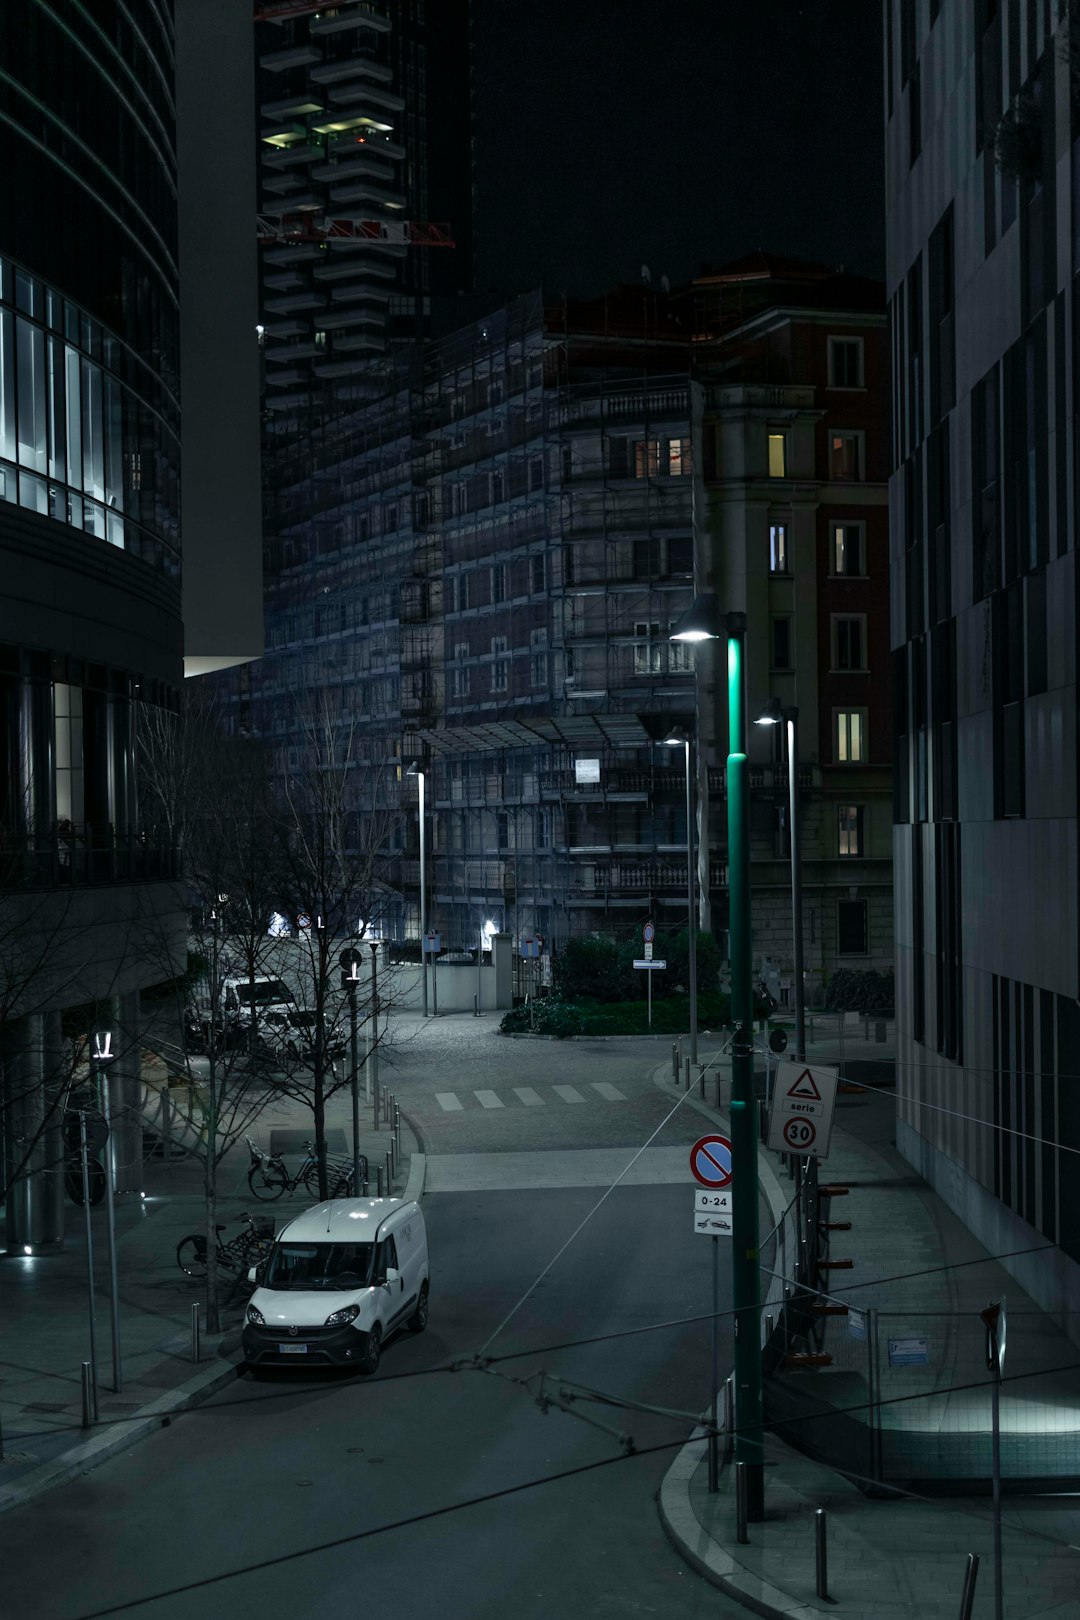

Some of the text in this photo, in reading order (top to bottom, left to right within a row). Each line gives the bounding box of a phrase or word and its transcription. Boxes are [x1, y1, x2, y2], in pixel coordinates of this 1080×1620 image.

[791, 1104, 815, 1113] serie
[789, 1124, 810, 1141] 30
[701, 1196, 727, 1206] 0-24
